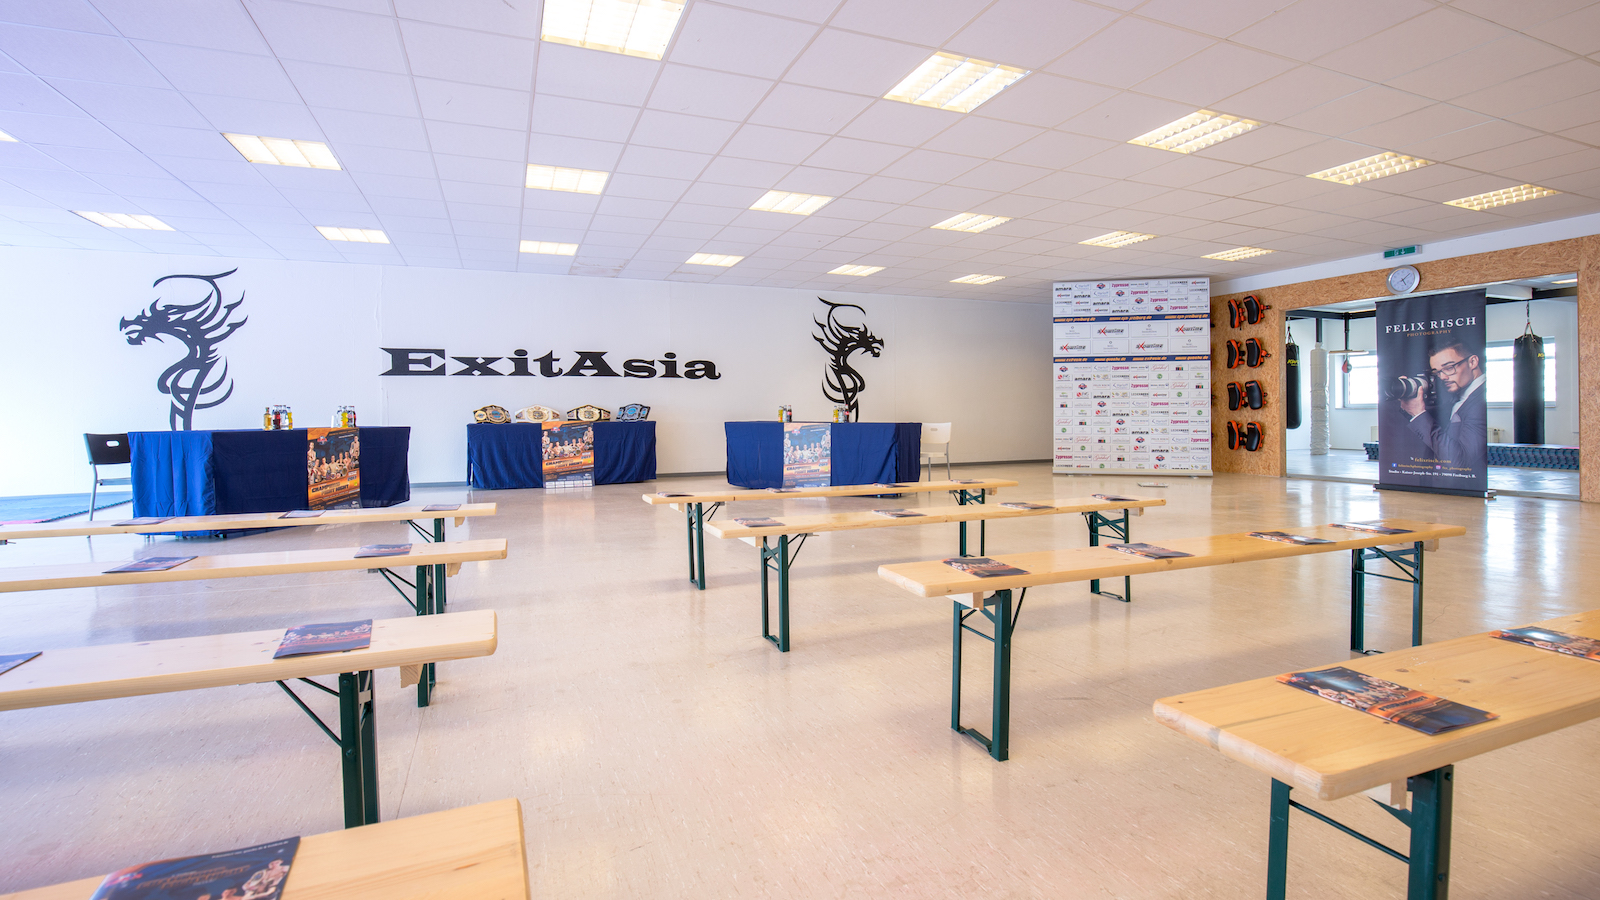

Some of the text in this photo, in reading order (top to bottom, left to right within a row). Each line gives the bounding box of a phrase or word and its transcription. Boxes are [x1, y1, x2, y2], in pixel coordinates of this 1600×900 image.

[1385, 316, 1476, 333] FELIX RISCH
[378, 347, 721, 380] ExitAsia
